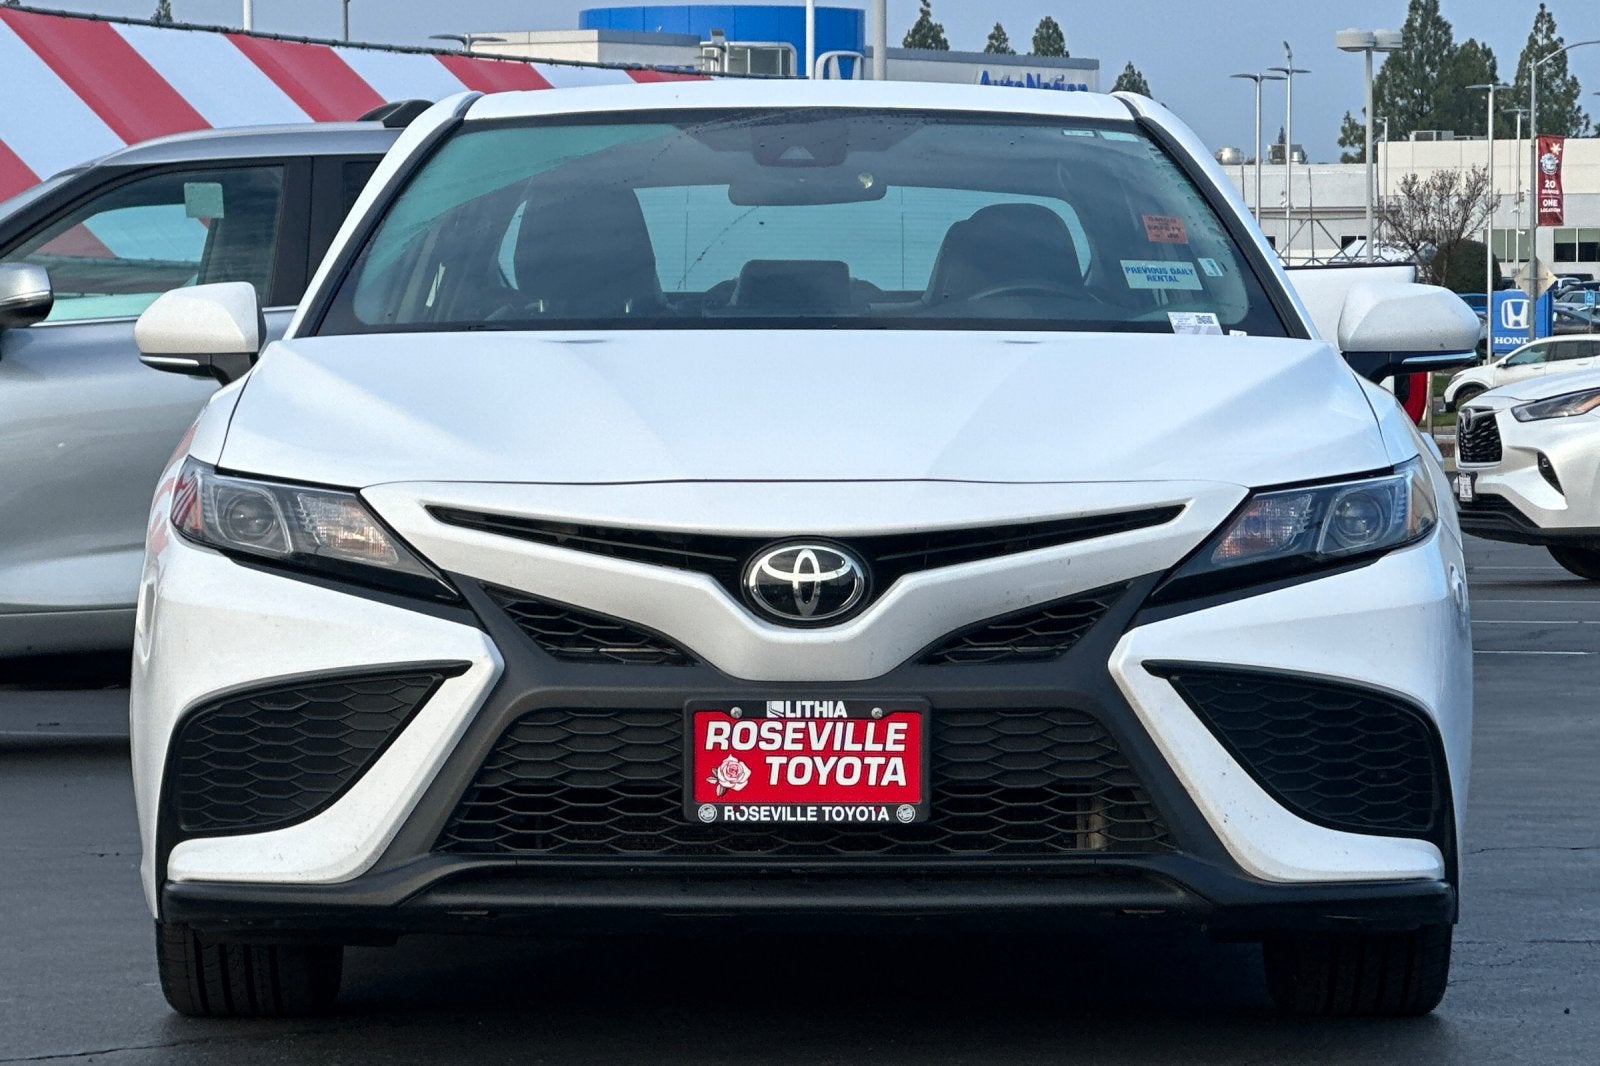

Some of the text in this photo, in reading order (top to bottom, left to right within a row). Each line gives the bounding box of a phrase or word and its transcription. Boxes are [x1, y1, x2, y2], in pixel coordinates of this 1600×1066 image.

[1544, 180, 1556, 188] 20
[1542, 199, 1558, 207] ONE
[1125, 266, 1168, 274] PREVIOUS
[786, 701, 848, 718] LITHIA
[705, 720, 908, 752] ROSEVILLE
[765, 756, 907, 786] TOYOTA
[724, 805, 818, 821] ROSEVILLE
[822, 805, 890, 821] TOYOTA
